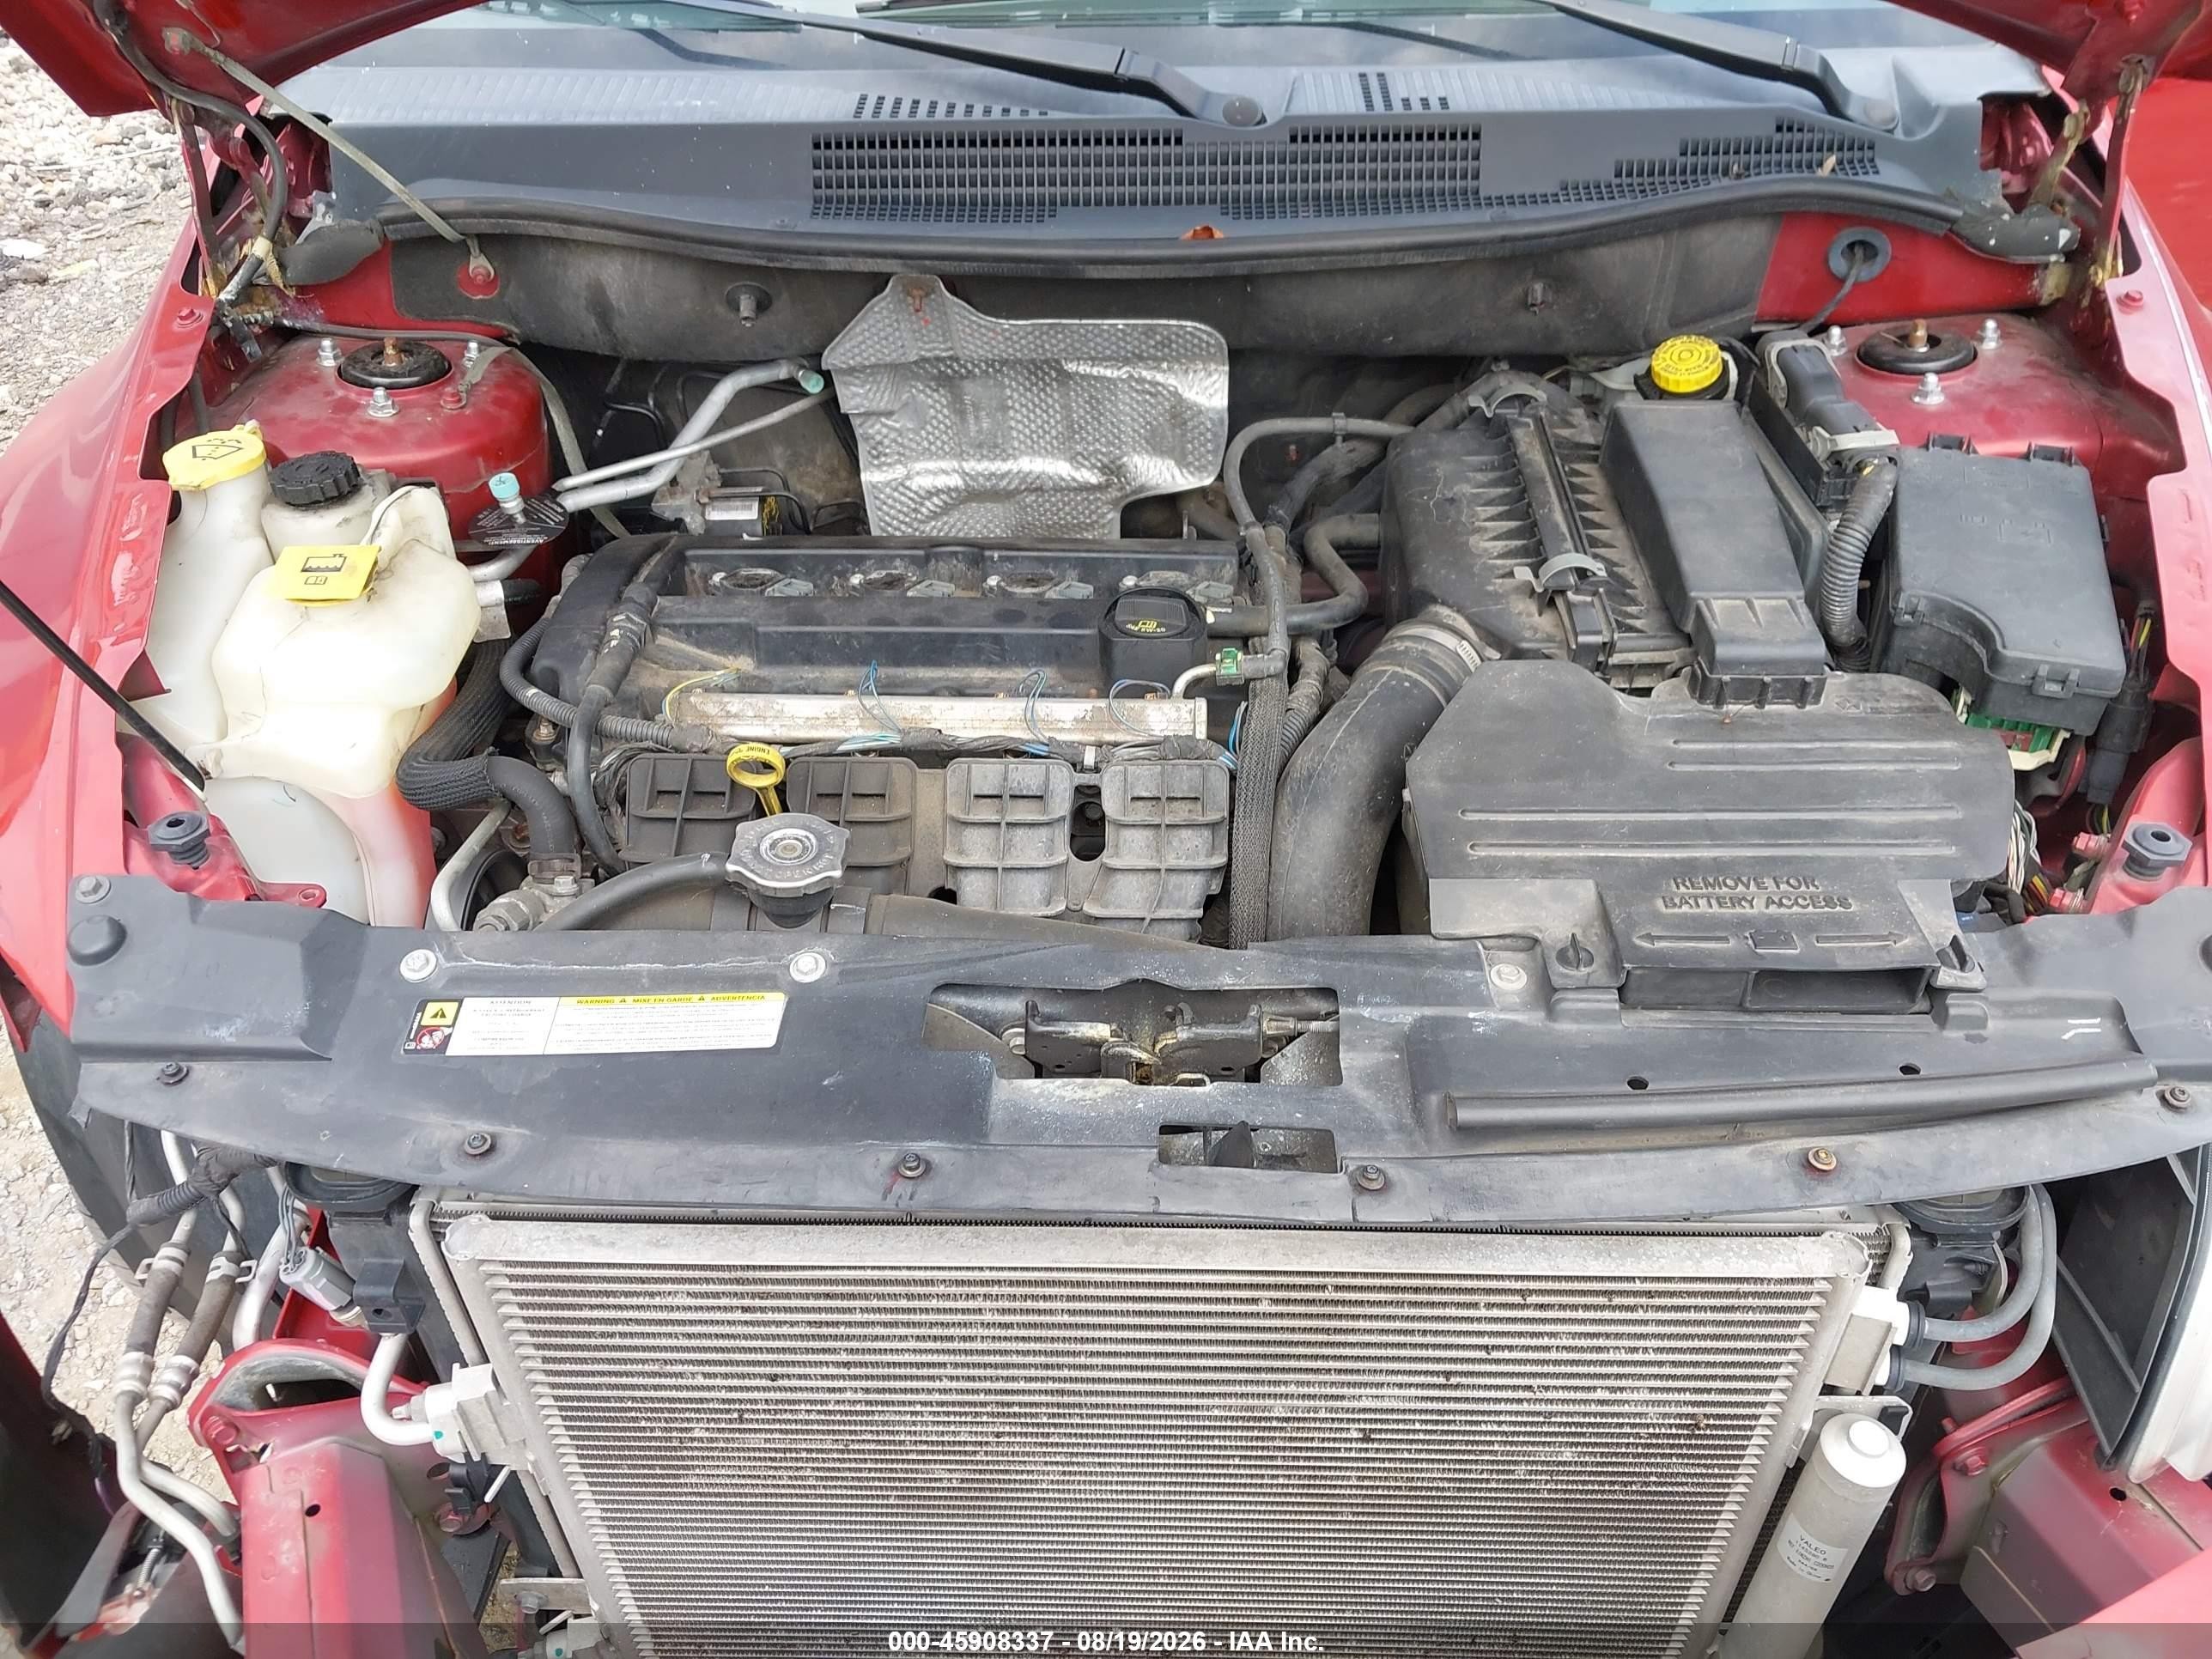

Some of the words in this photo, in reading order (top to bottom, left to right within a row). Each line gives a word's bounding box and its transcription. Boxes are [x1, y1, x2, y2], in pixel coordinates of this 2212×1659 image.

[1672, 876, 1768, 890] REMOVE
[1771, 876, 1820, 890] FOR
[1662, 895, 1756, 910] BATTERY
[1765, 895, 1853, 910] ACCESS
[1800, 1534, 1826, 1555] VALEO
